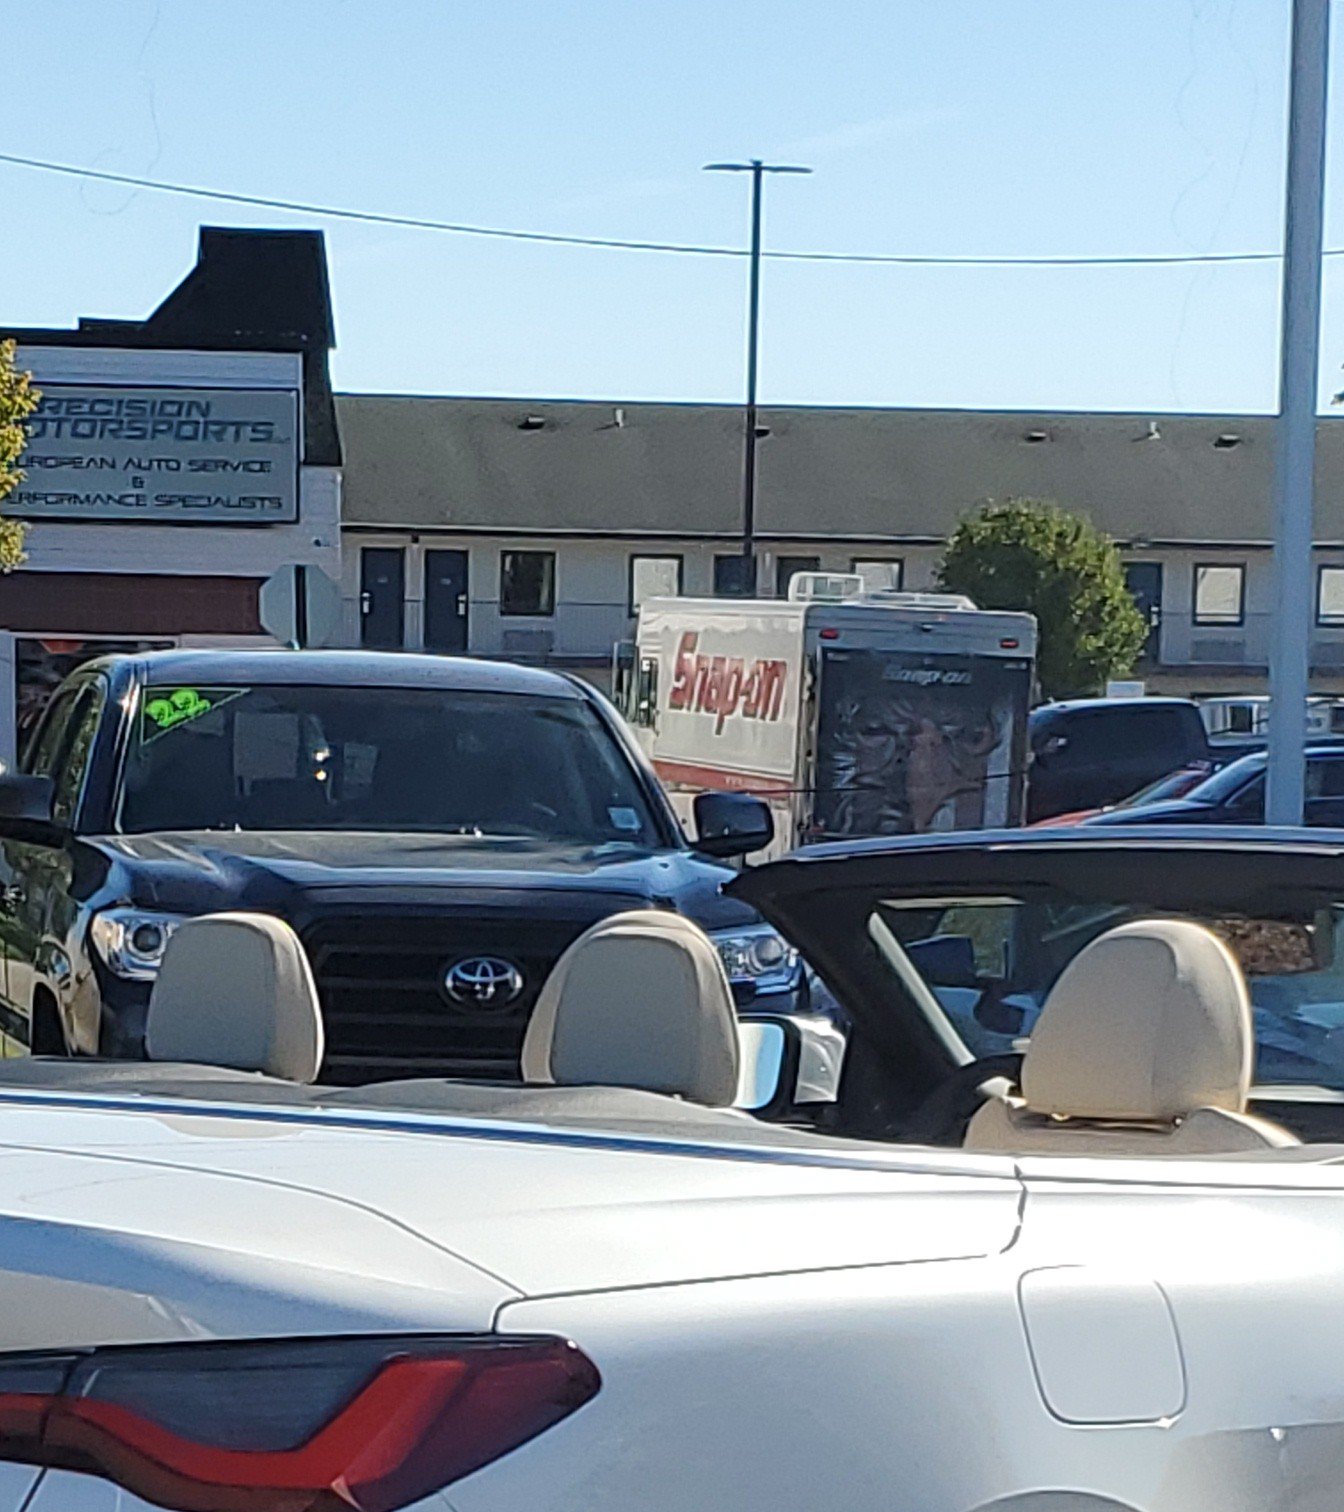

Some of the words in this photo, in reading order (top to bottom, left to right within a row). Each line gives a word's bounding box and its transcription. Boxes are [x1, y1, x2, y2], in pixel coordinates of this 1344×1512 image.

[37, 397, 211, 418] RECISION
[17, 417, 275, 443] OTORSPORTS
[123, 457, 181, 471] AUTO
[188, 458, 272, 473] SERVICE
[669, 631, 787, 736] Snap-on
[145, 687, 211, 728] 22
